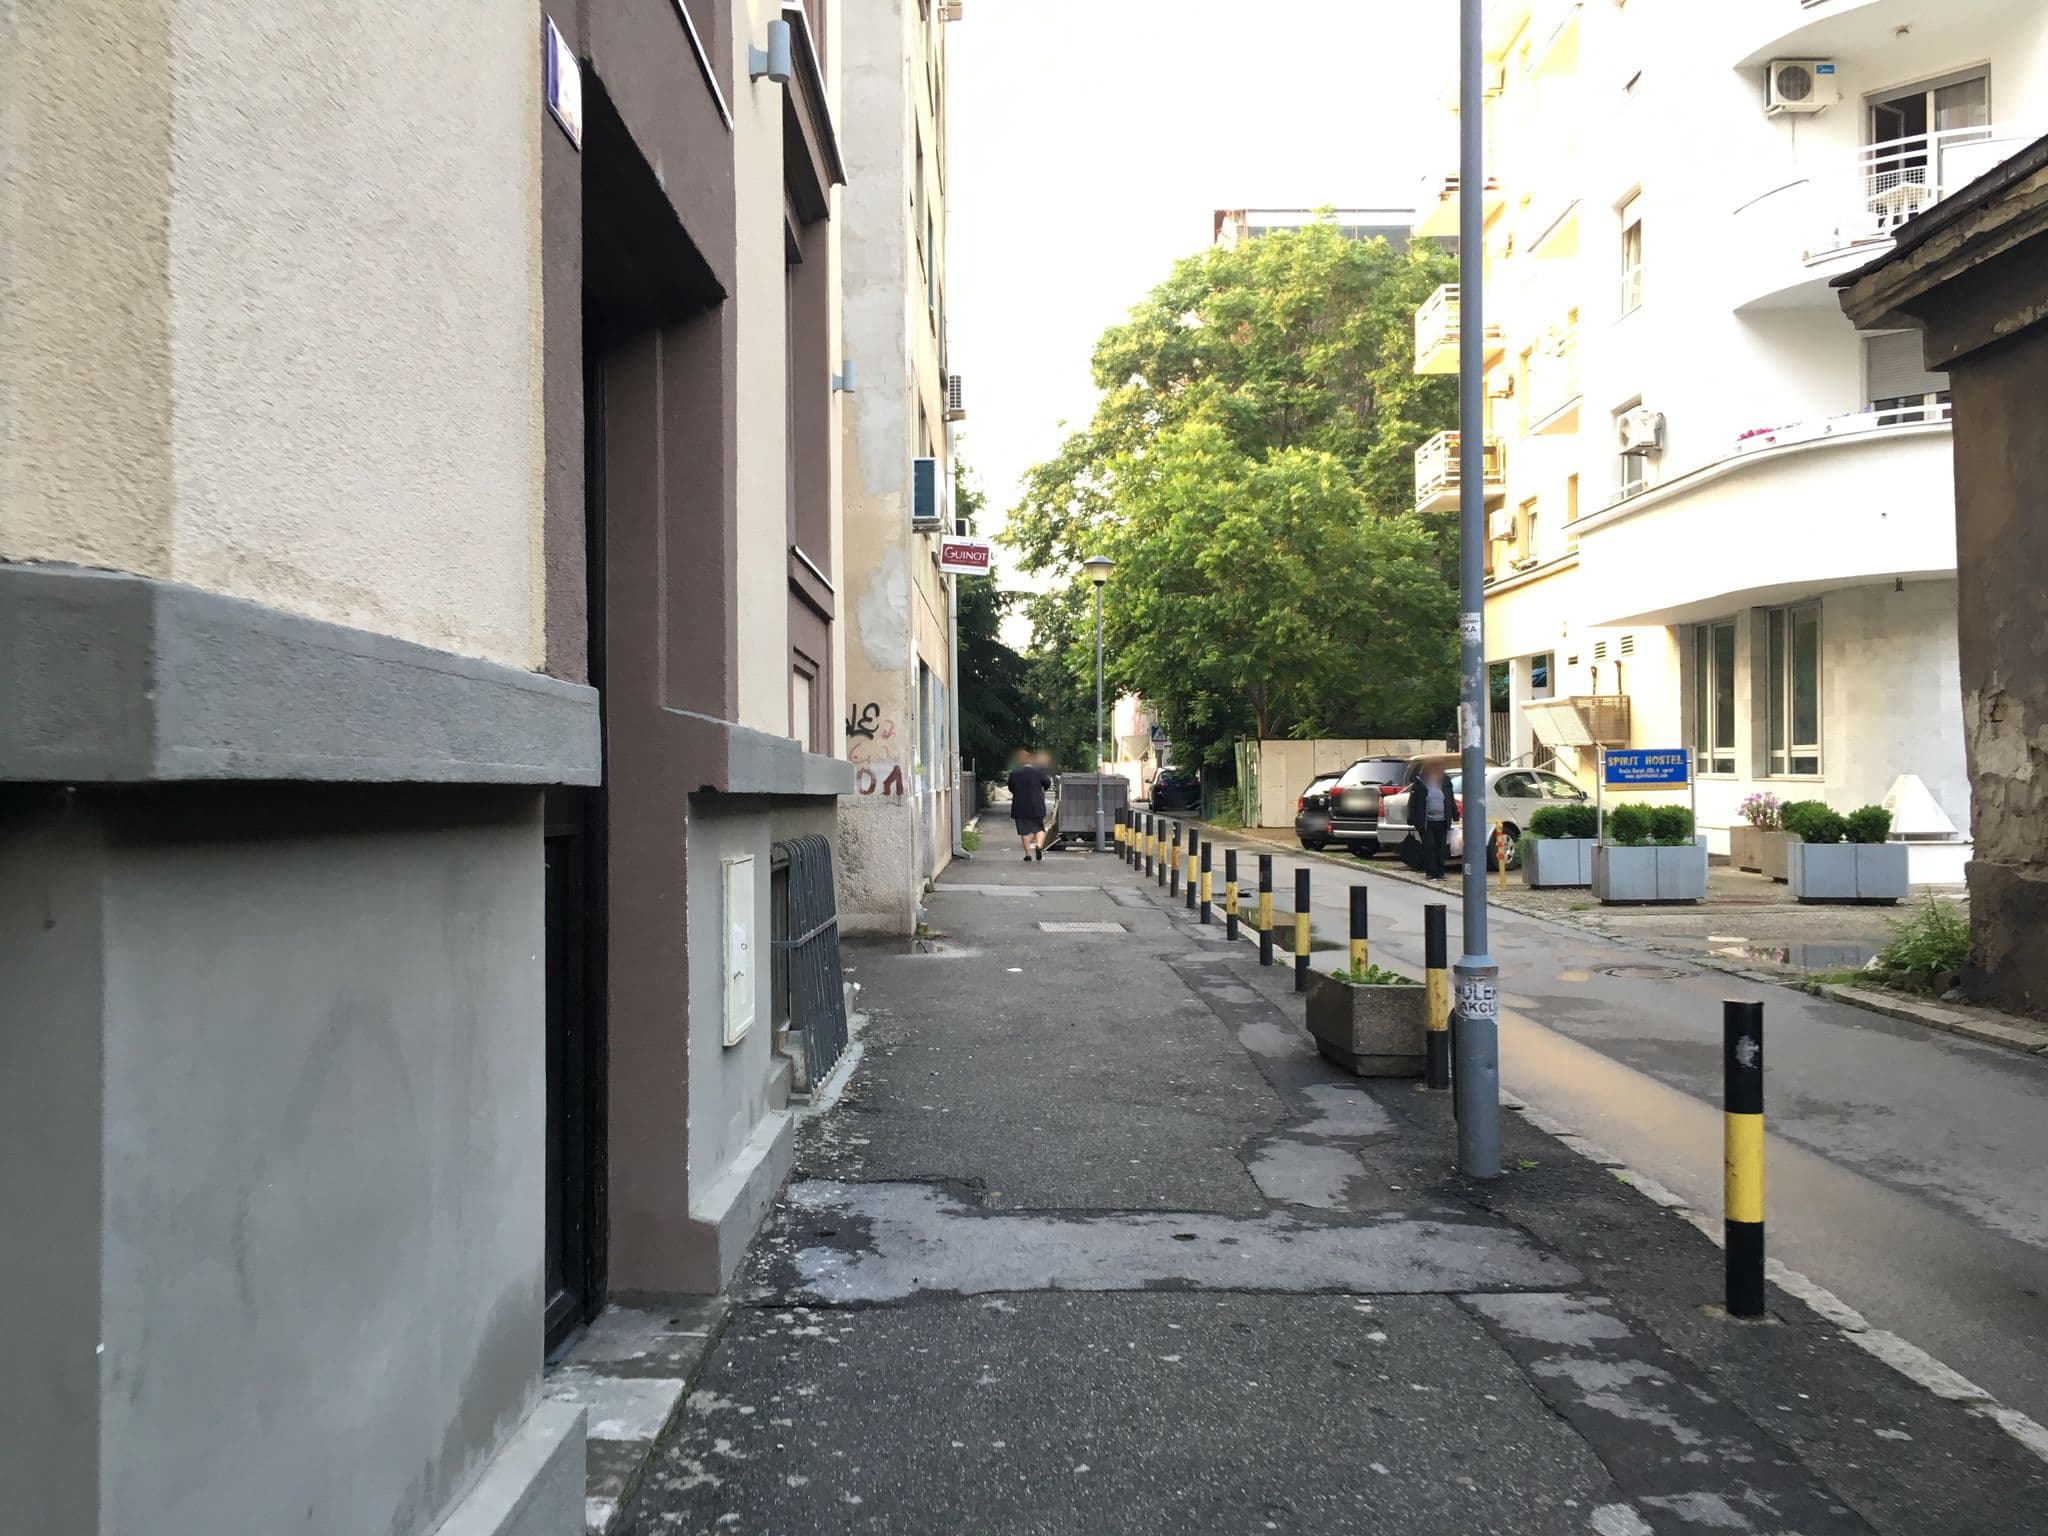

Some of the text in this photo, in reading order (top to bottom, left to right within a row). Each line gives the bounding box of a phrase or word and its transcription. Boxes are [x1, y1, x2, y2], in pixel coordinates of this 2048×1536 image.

[944, 546, 987, 561] GUINOT
[1607, 754, 1684, 767] SPIRIT HOSTEL
